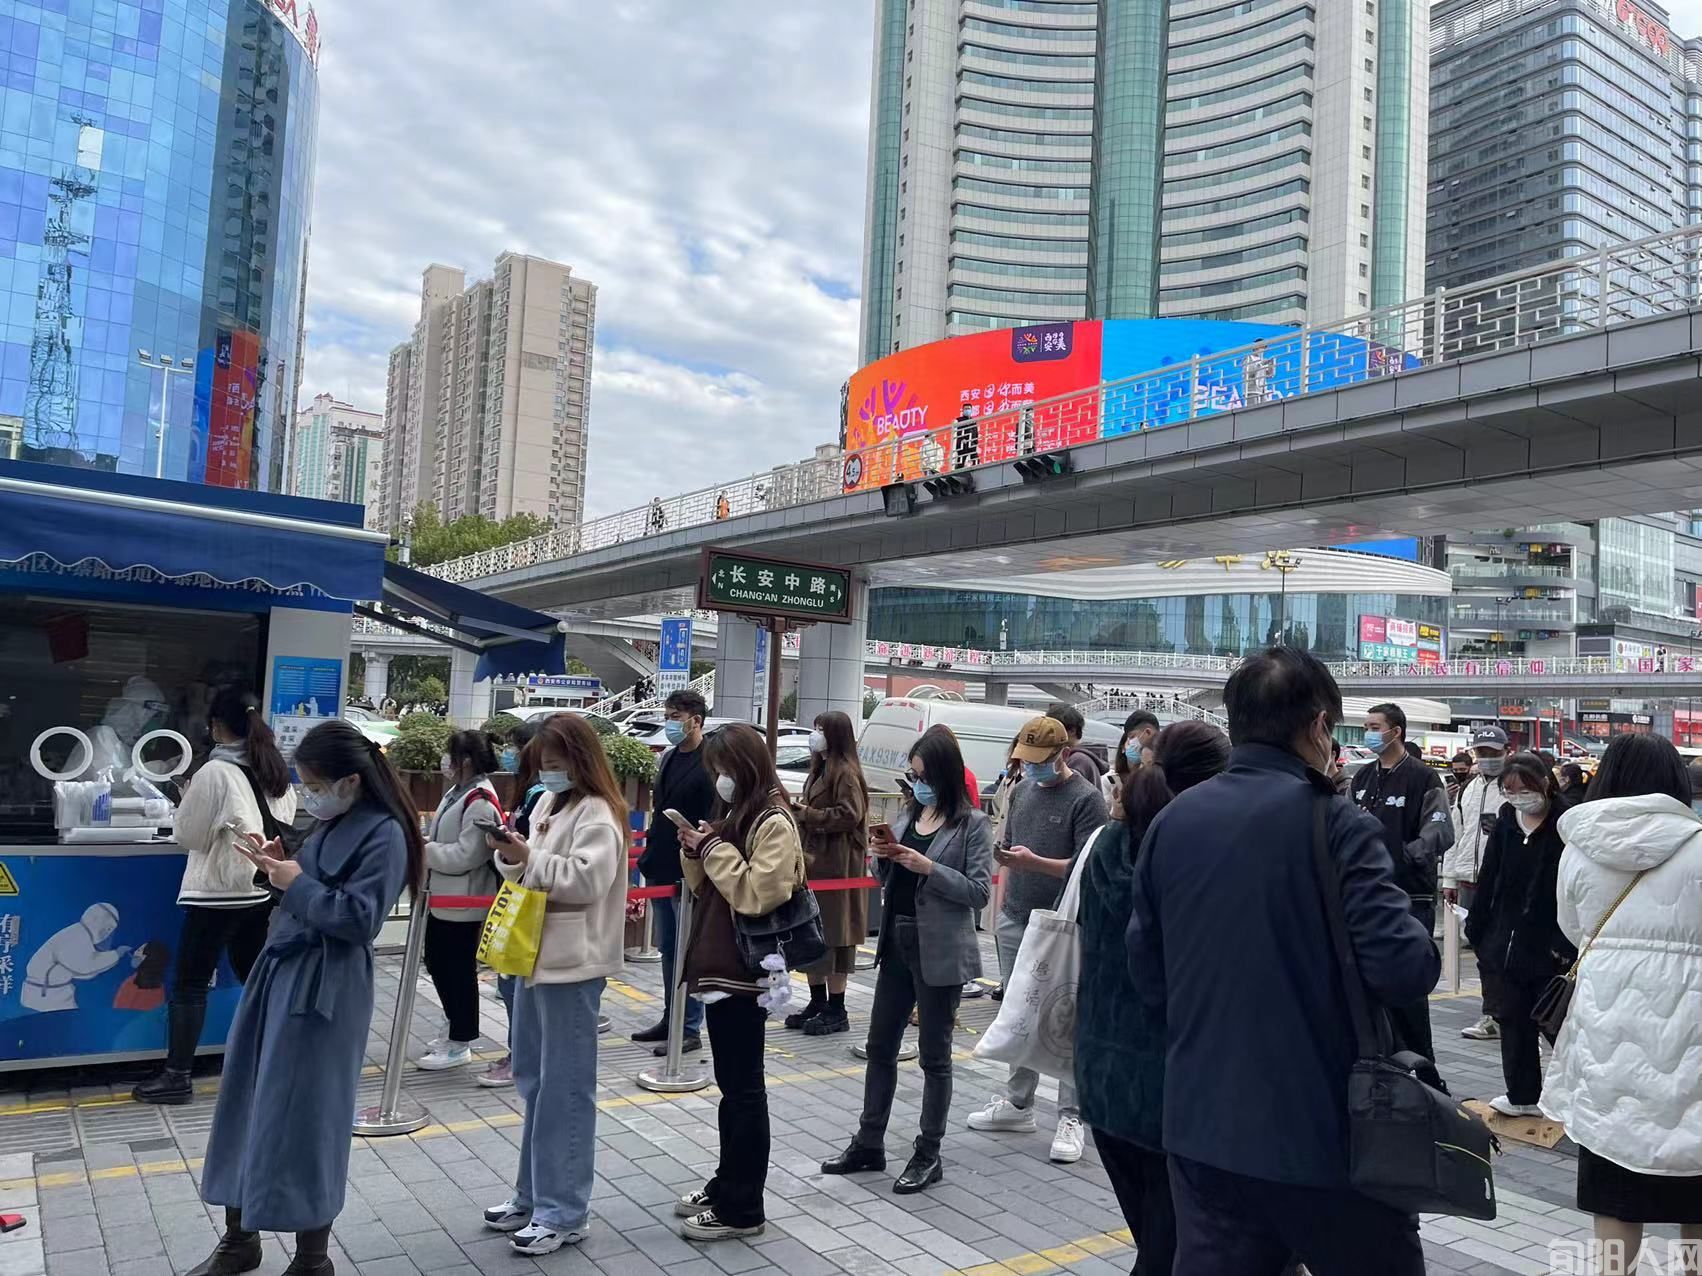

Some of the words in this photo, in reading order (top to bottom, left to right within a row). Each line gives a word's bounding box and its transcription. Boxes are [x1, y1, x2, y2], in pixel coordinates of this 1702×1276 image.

[877, 405, 929, 436] BEAUTY
[729, 564, 826, 595] 长安中路
[730, 588, 778, 603] CHANG'AN
[782, 595, 824, 608] ZHONGLU
[1408, 660, 1545, 676] 人民有信仰
[1638, 656, 1694, 673] 国家
[1026, 734, 1035, 744] R
[479, 921, 493, 954] TOP
[491, 885, 513, 918] TOY
